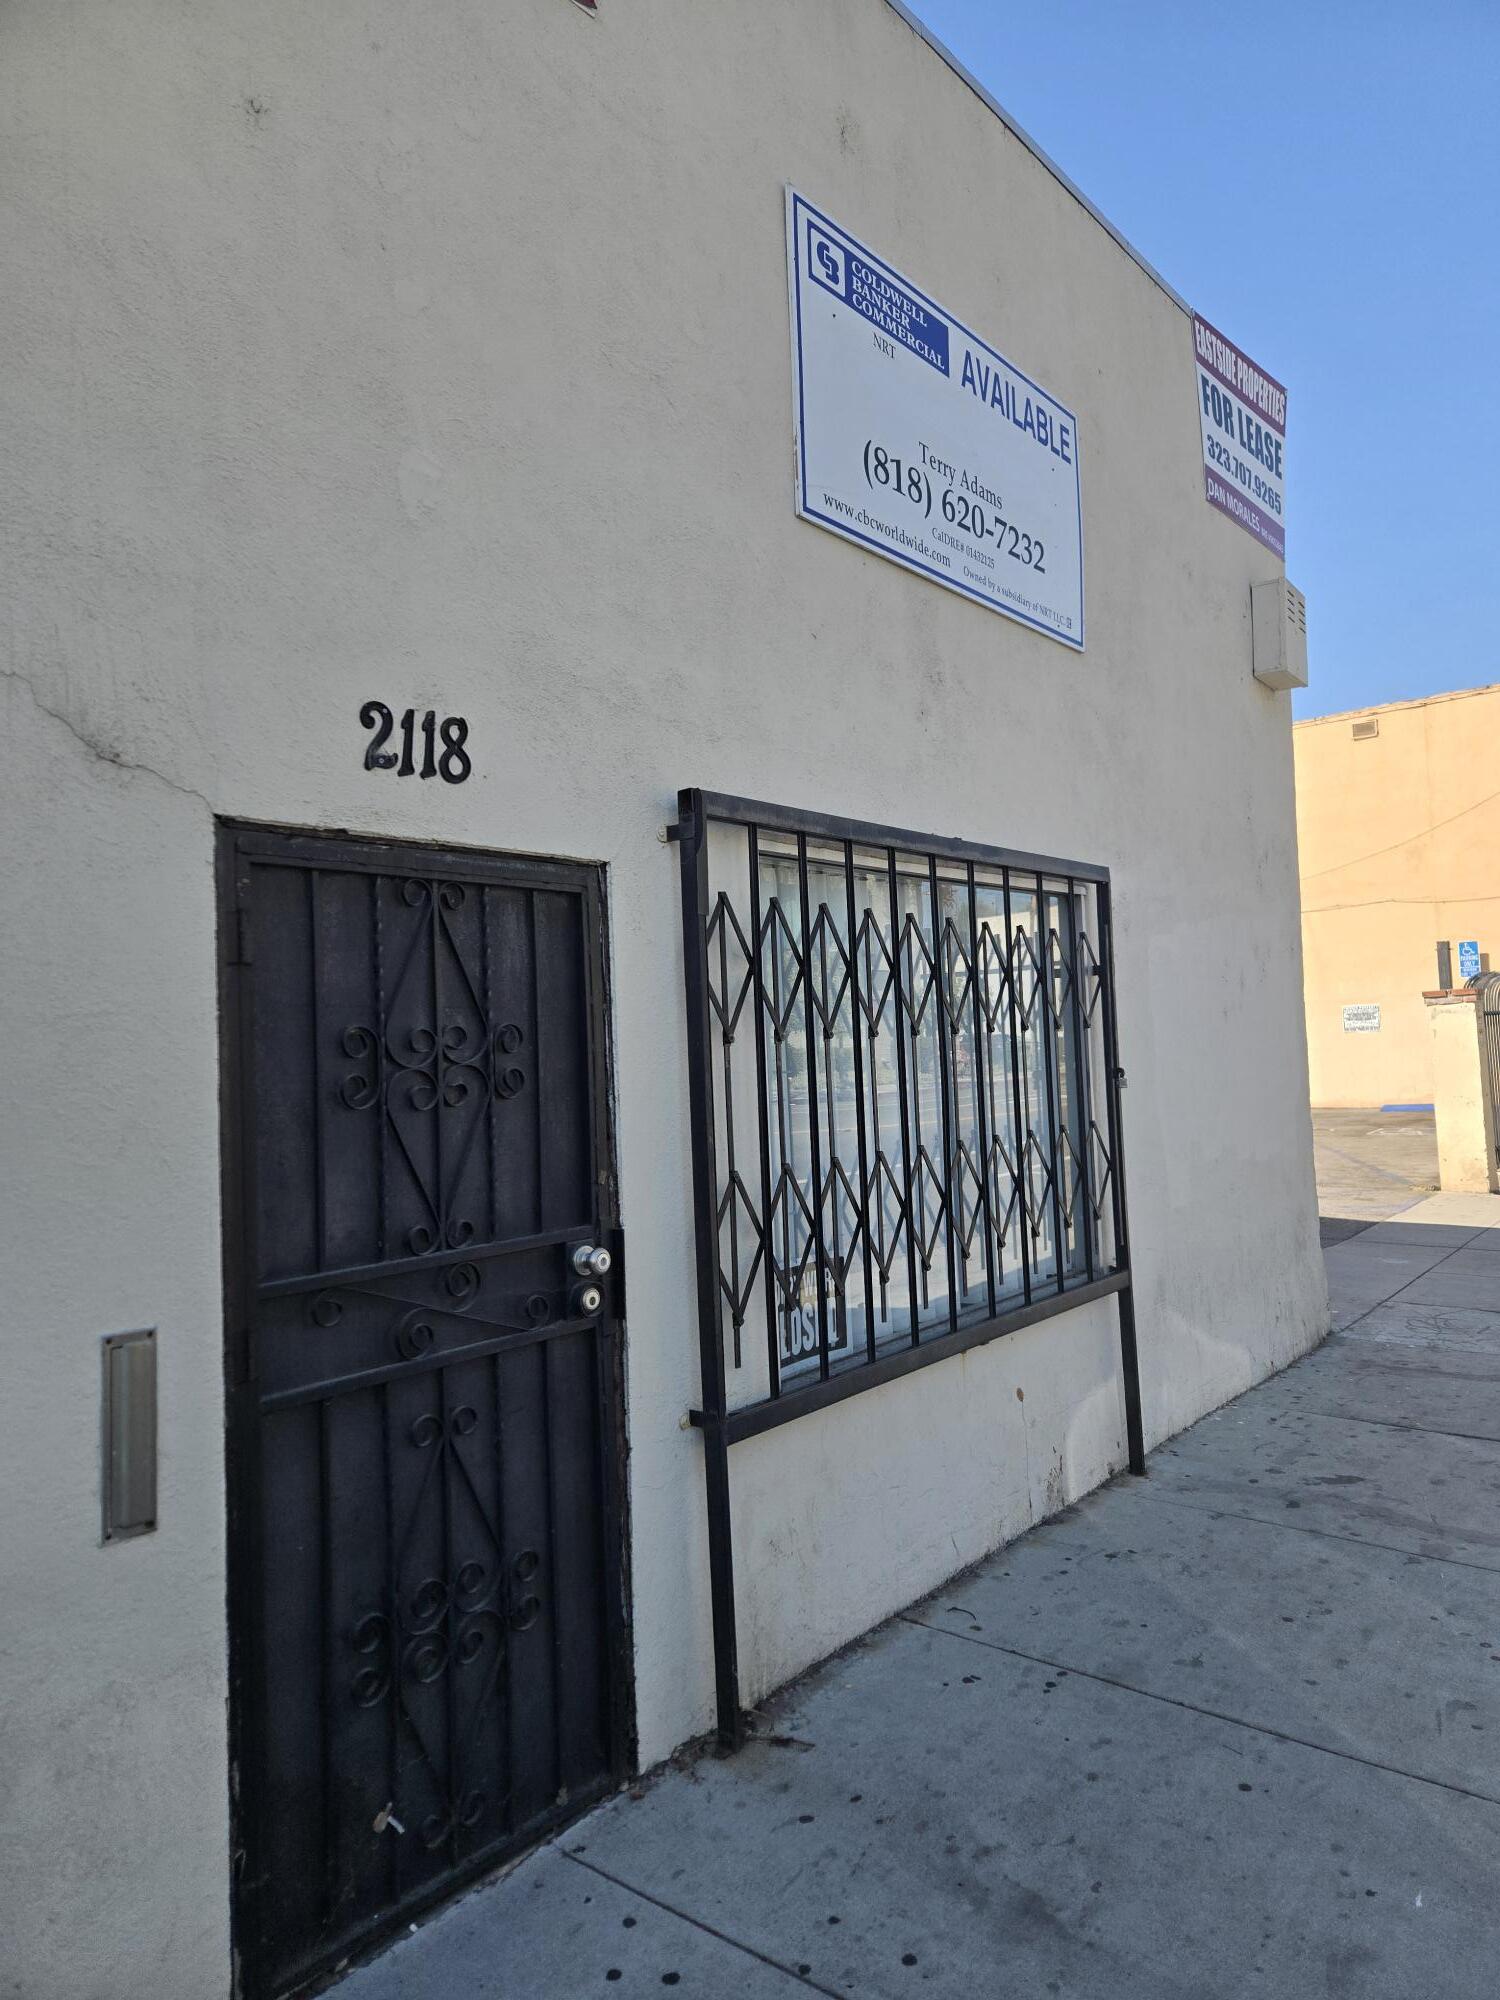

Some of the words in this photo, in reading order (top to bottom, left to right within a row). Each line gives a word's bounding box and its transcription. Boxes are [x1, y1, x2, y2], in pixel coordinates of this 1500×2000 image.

[851, 260, 928, 328] COLDWELL
[851, 277, 911, 330] BANKER
[851, 293, 945, 370] COMMERCIAL
[872, 332, 897, 360] NRT
[1194, 320, 1238, 387] EASTSIDE
[1237, 356, 1285, 426] PROPERTIES
[961, 349, 1072, 466] AVAILABLE
[1200, 373, 1235, 440] FOR
[1237, 407, 1283, 480] LEASE
[863, 439, 932, 520] (818)
[941, 489, 1047, 574] 620-7232
[918, 441, 956, 487] Terry
[960, 469, 1004, 510] Adams
[1207, 434, 1282, 516] 323.707.9265
[1207, 478, 1227, 506] DAN
[1226, 492, 1261, 533] MORALES
[823, 493, 951, 569] www.cbcworldwide.com
[963, 565, 987, 587] Owned
[987, 578, 996, 593] by
[1001, 586, 1032, 611] subsidiary
[359, 700, 472, 785] 2118
